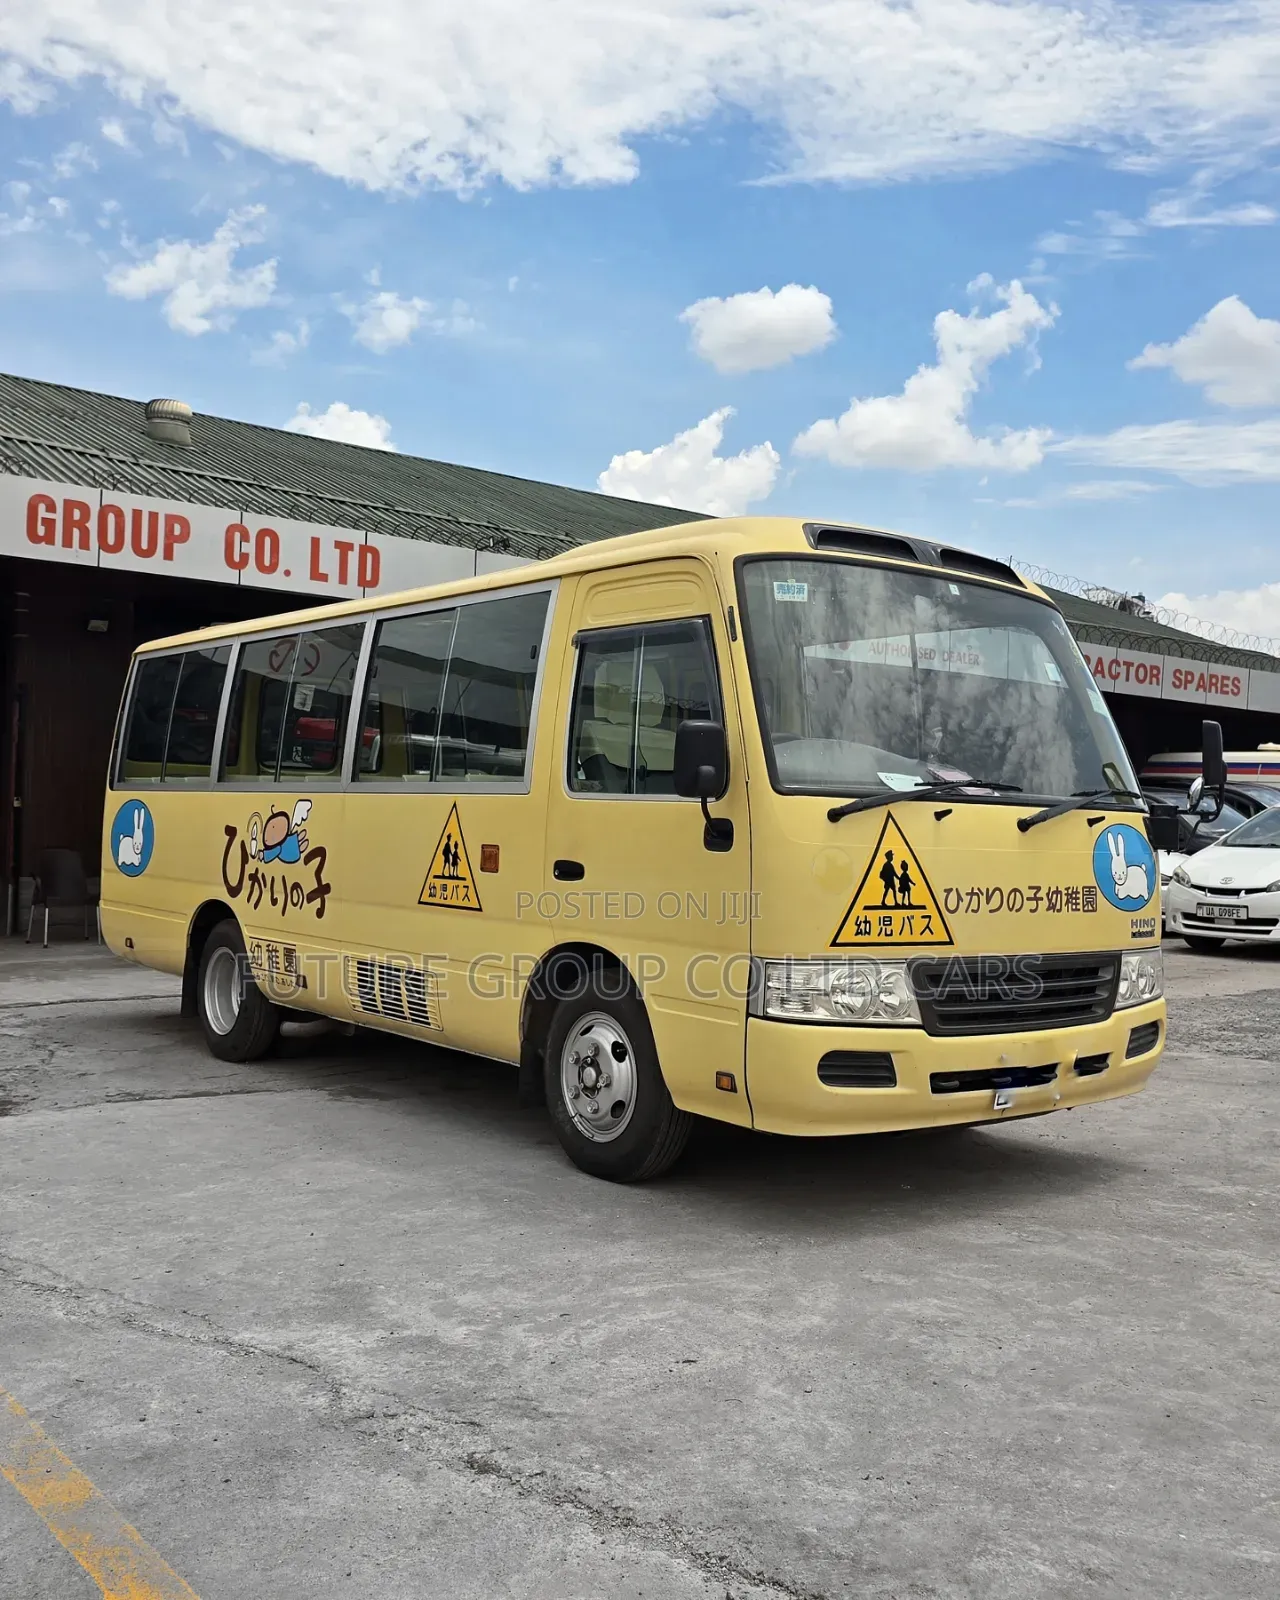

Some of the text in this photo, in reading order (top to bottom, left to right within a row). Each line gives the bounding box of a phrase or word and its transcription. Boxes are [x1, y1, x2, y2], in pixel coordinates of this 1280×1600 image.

[25, 493, 381, 589] GROUP CO. LTD
[942, 650, 980, 666] DEALER
[1171, 668, 1241, 697] SPARES
[222, 824, 331, 919] ひかりの子
[428, 881, 471, 903] 幼児バス
[943, 886, 1098, 914] ひかりの子幼稚園
[1130, 918, 1156, 929] HINO
[1206, 906, 1216, 917] UA
[854, 915, 934, 938] 幼児バス
[249, 940, 298, 975] 幼稚園
